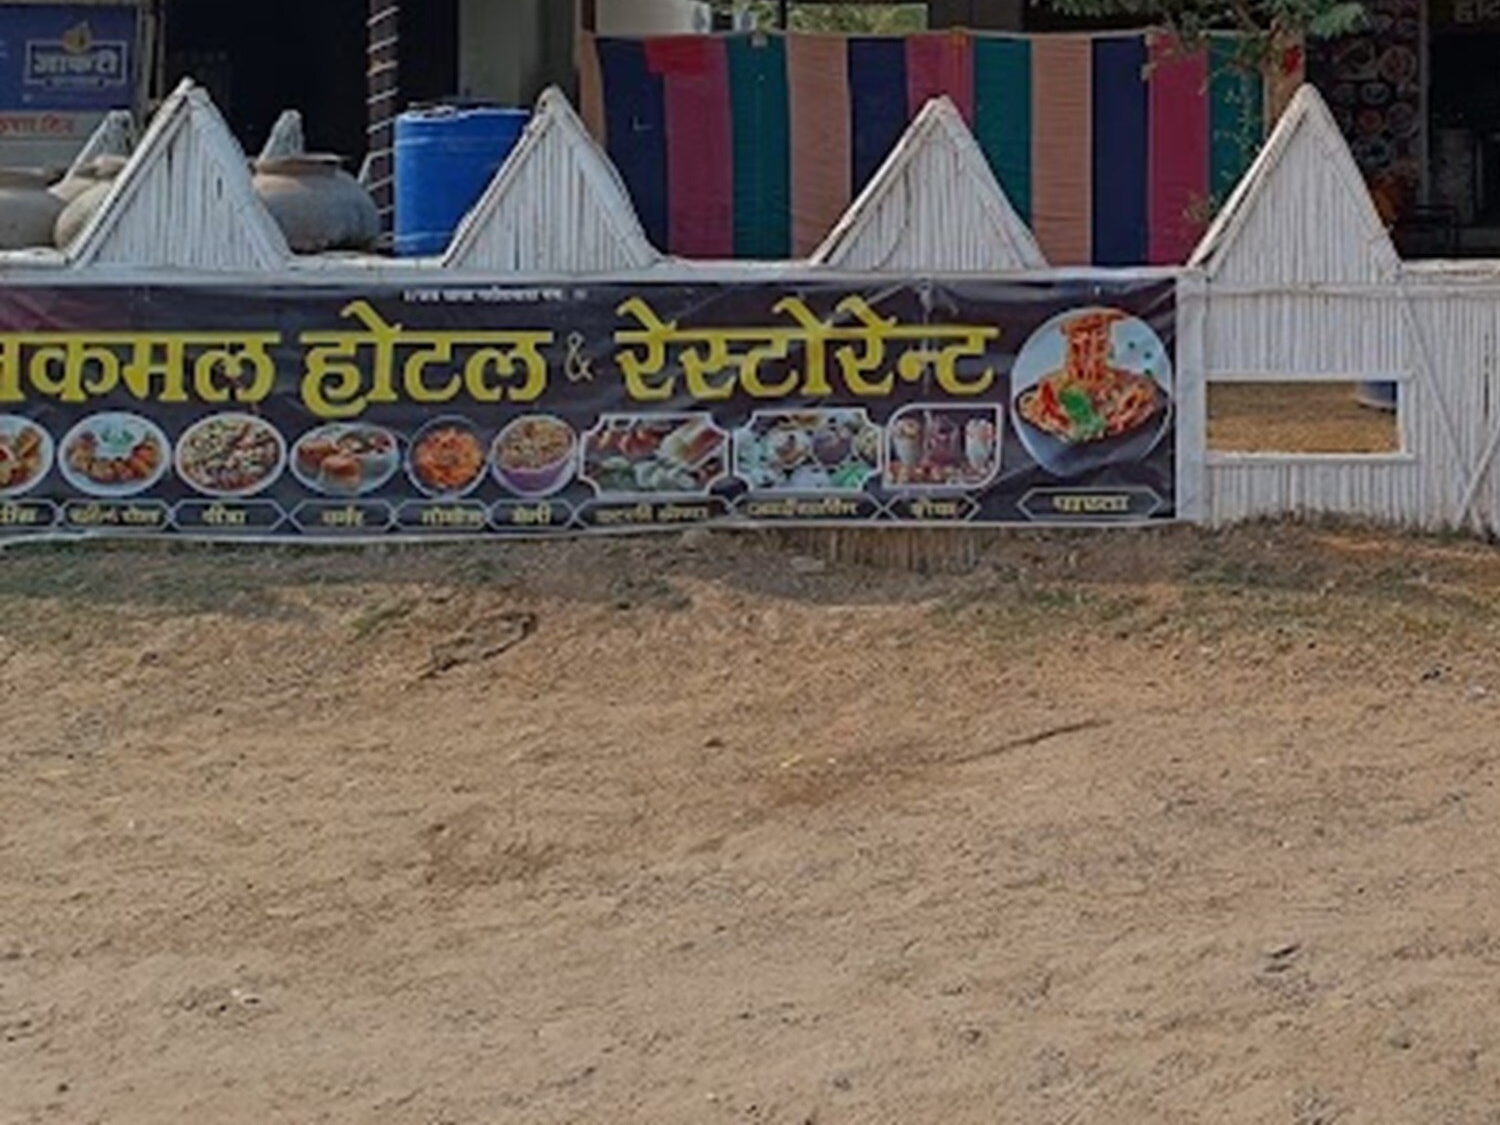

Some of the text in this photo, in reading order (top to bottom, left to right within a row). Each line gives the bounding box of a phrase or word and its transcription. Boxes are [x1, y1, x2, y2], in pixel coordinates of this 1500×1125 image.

[299, 299, 553, 420] होटल
[565, 331, 594, 383] &
[613, 295, 1001, 402] रेस्टोरेन्ट
